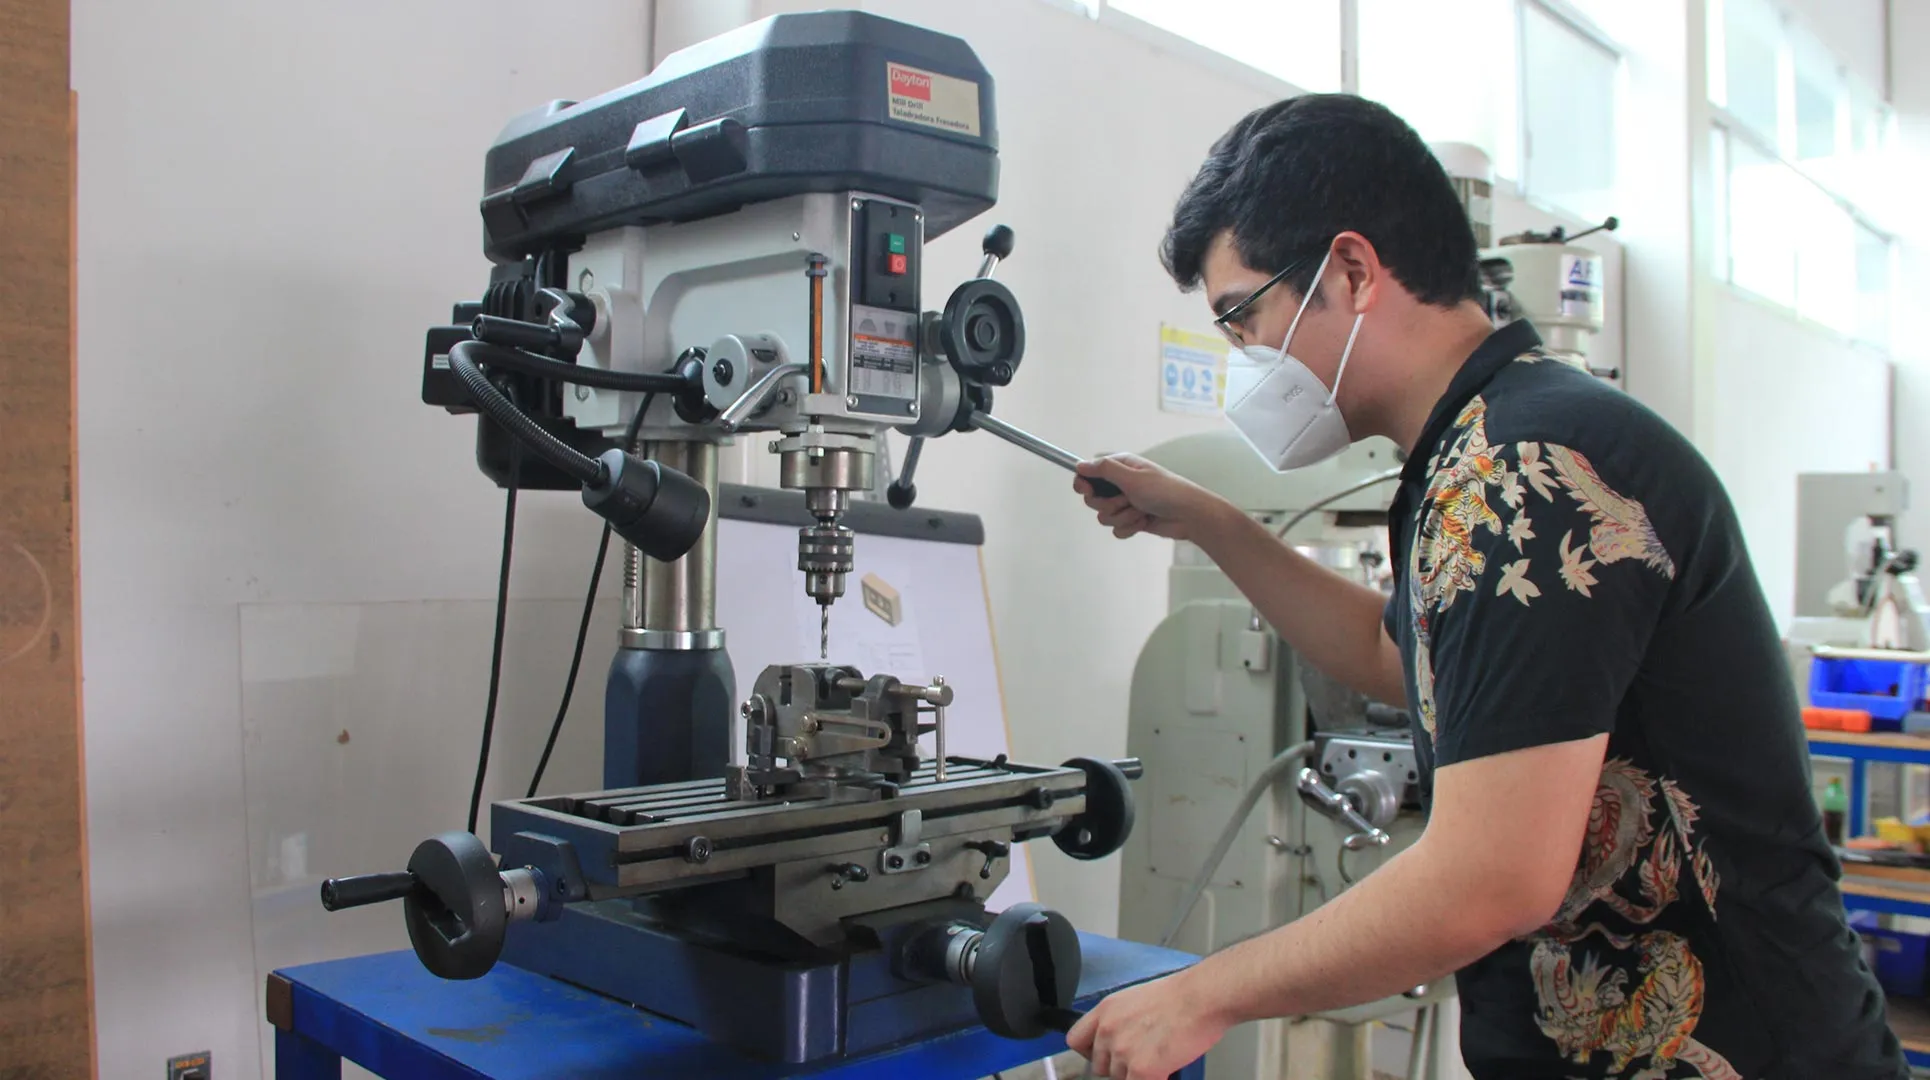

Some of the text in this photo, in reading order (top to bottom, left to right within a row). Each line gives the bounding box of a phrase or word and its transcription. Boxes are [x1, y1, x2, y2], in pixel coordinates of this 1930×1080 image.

[892, 70, 930, 88] Dayton
[892, 97, 924, 109] Mill Drill
[893, 107, 969, 130] Taladradora Fresadora
